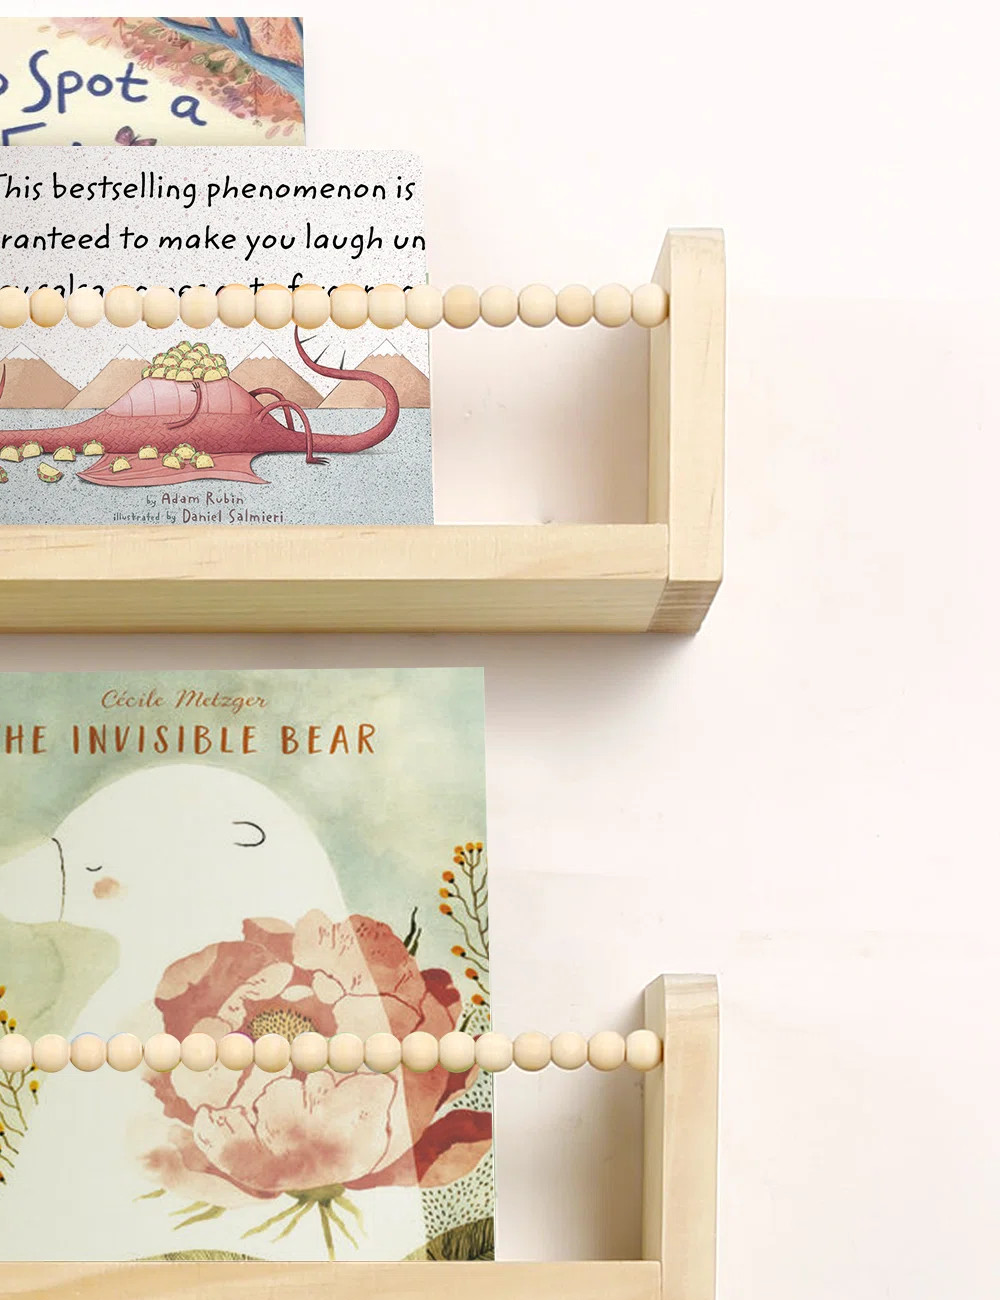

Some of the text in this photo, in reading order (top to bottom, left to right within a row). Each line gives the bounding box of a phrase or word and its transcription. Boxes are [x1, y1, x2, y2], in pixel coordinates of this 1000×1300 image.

[21, 49, 149, 114] Spot
[171, 95, 207, 126] a
[52, 171, 197, 208] bestselling
[207, 175, 386, 208] phenomenon
[396, 176, 416, 201] is
[119, 226, 149, 250] to
[158, 225, 237, 250] make
[245, 234, 296, 262] you
[305, 222, 383, 260] laugh
[393, 234, 426, 251] un
[146, 491, 244, 507] by Adam Rubin
[113, 508, 285, 524] illustrated by Daniel Salmieri
[101, 688, 270, 715] Cécile Metzger
[71, 724, 259, 756] INVISIBLE
[281, 723, 377, 756] BEAR
